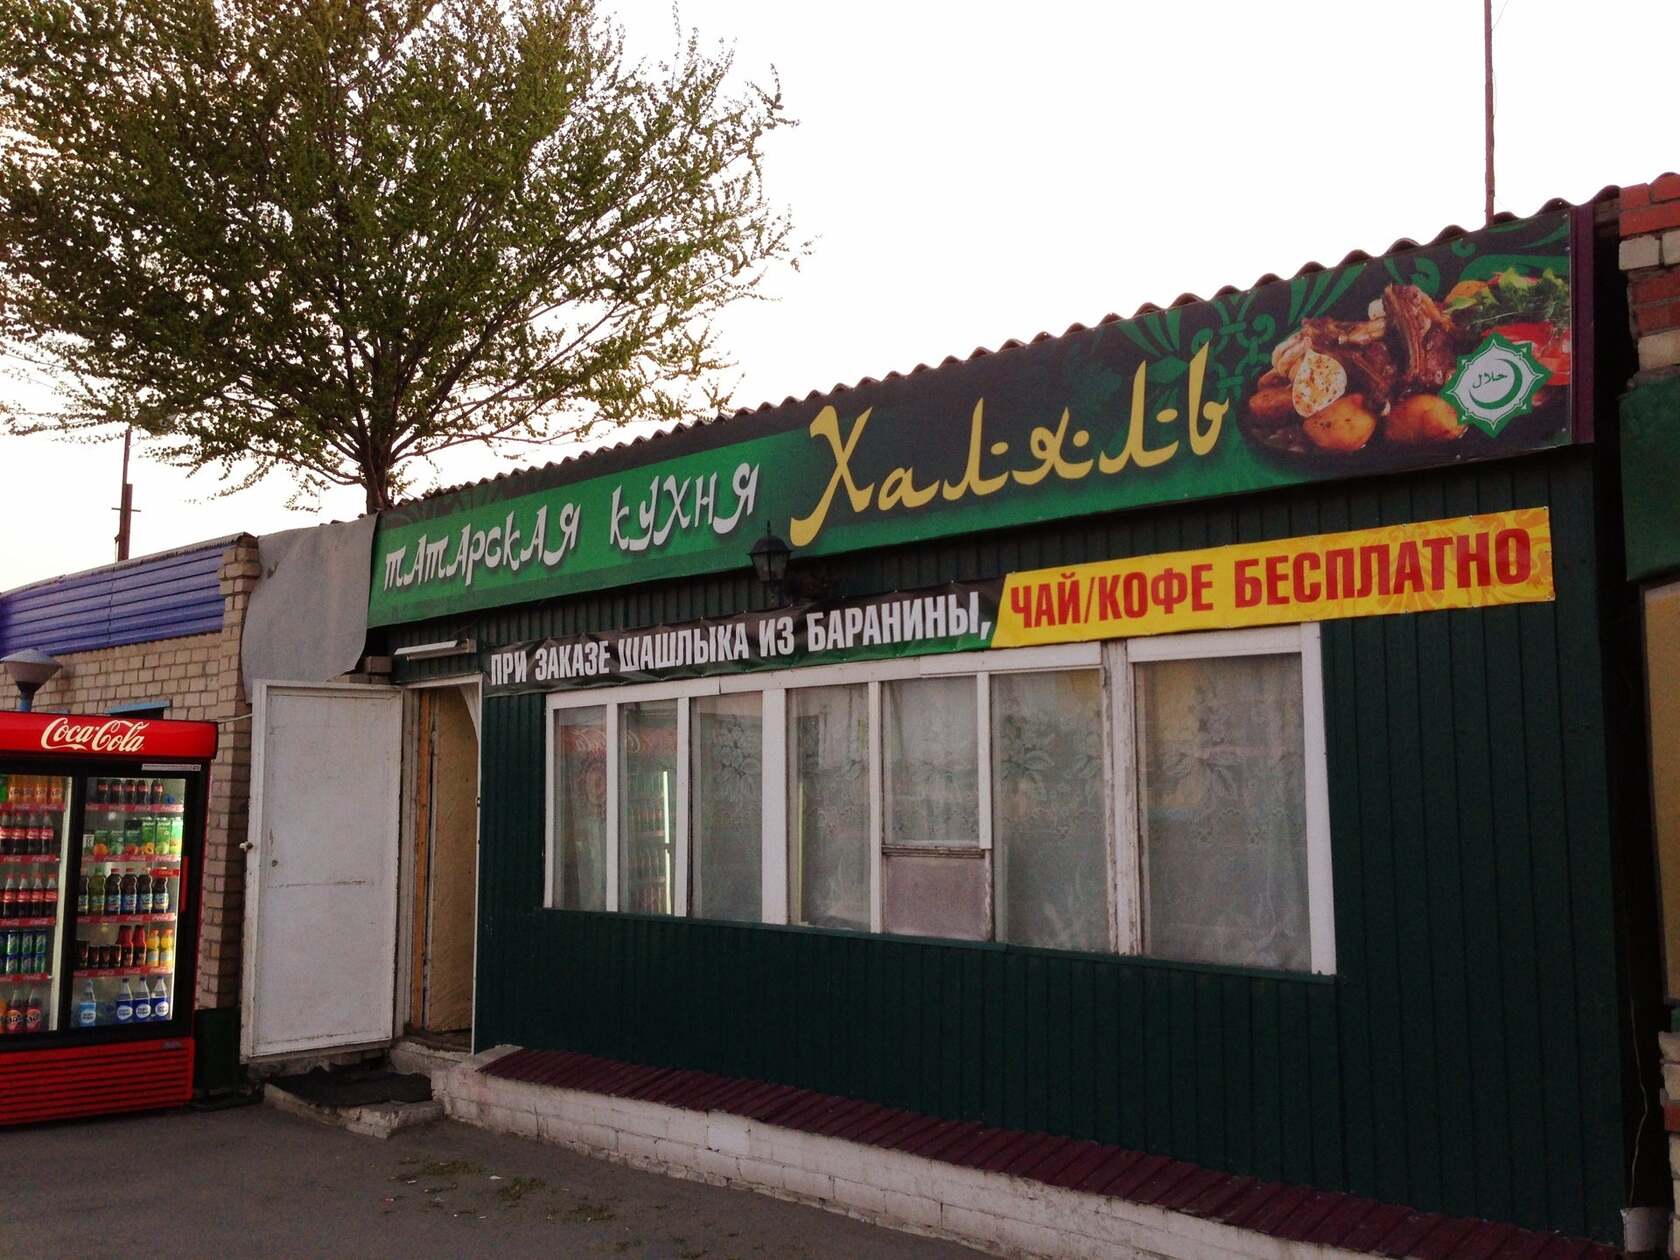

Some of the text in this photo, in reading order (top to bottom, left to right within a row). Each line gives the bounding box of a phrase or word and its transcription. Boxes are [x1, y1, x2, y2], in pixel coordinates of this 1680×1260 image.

[490, 527, 1531, 686] ПРИ ЗАКАЗЕ ШАШЛЫКА ИЗ БАРАНИНЫ, ЧАЙ/КОФЕ БЕСПЛАТНО
